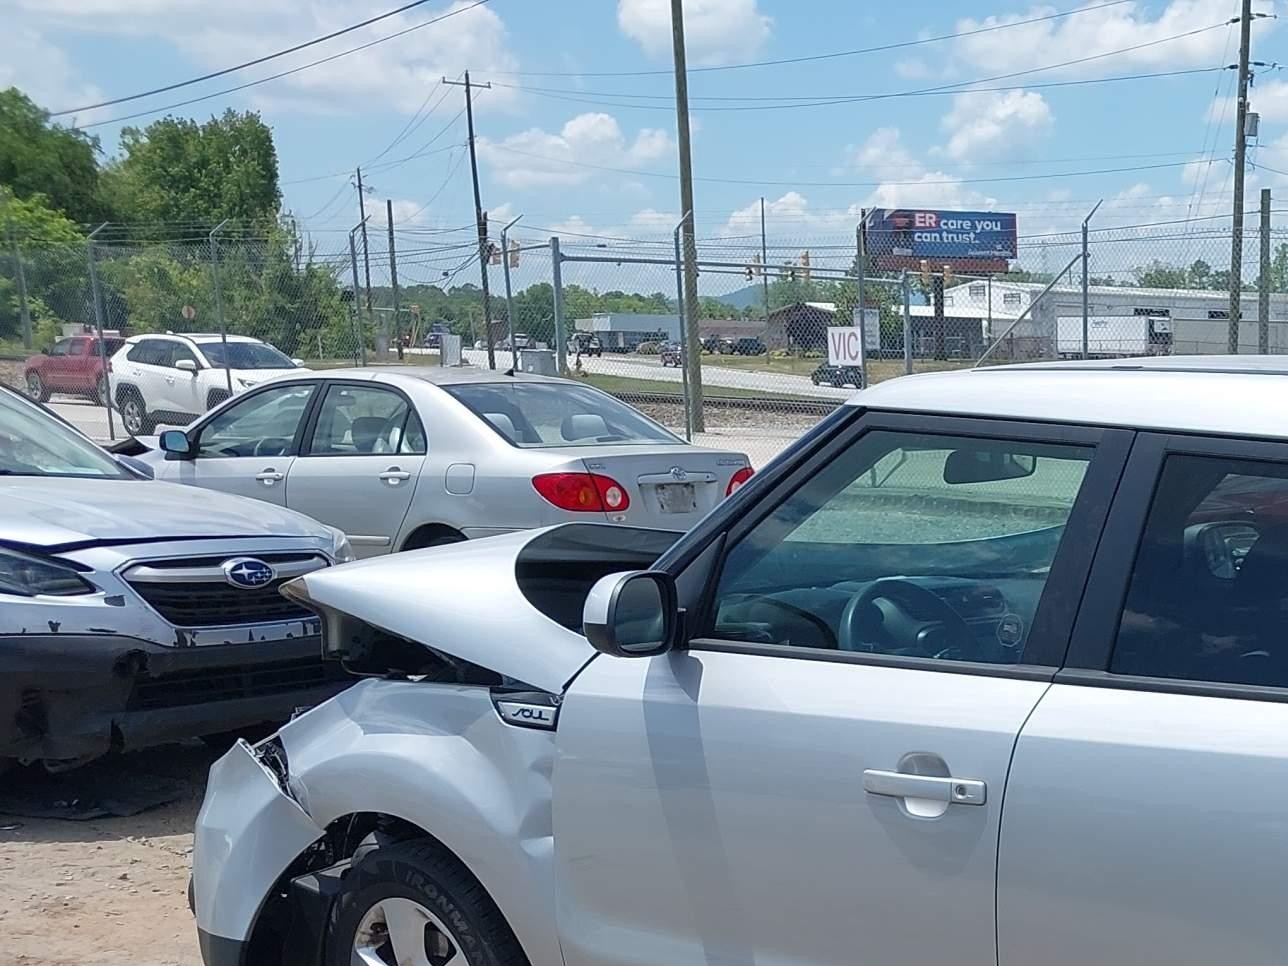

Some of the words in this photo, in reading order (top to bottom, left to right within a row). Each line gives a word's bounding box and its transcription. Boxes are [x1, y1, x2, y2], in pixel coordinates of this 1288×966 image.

[914, 213, 937, 227] ER
[940, 218, 972, 230] care
[975, 219, 1001, 233] you
[914, 232, 940, 243] can
[831, 332, 859, 361] VIC
[512, 708, 549, 721] SOUL
